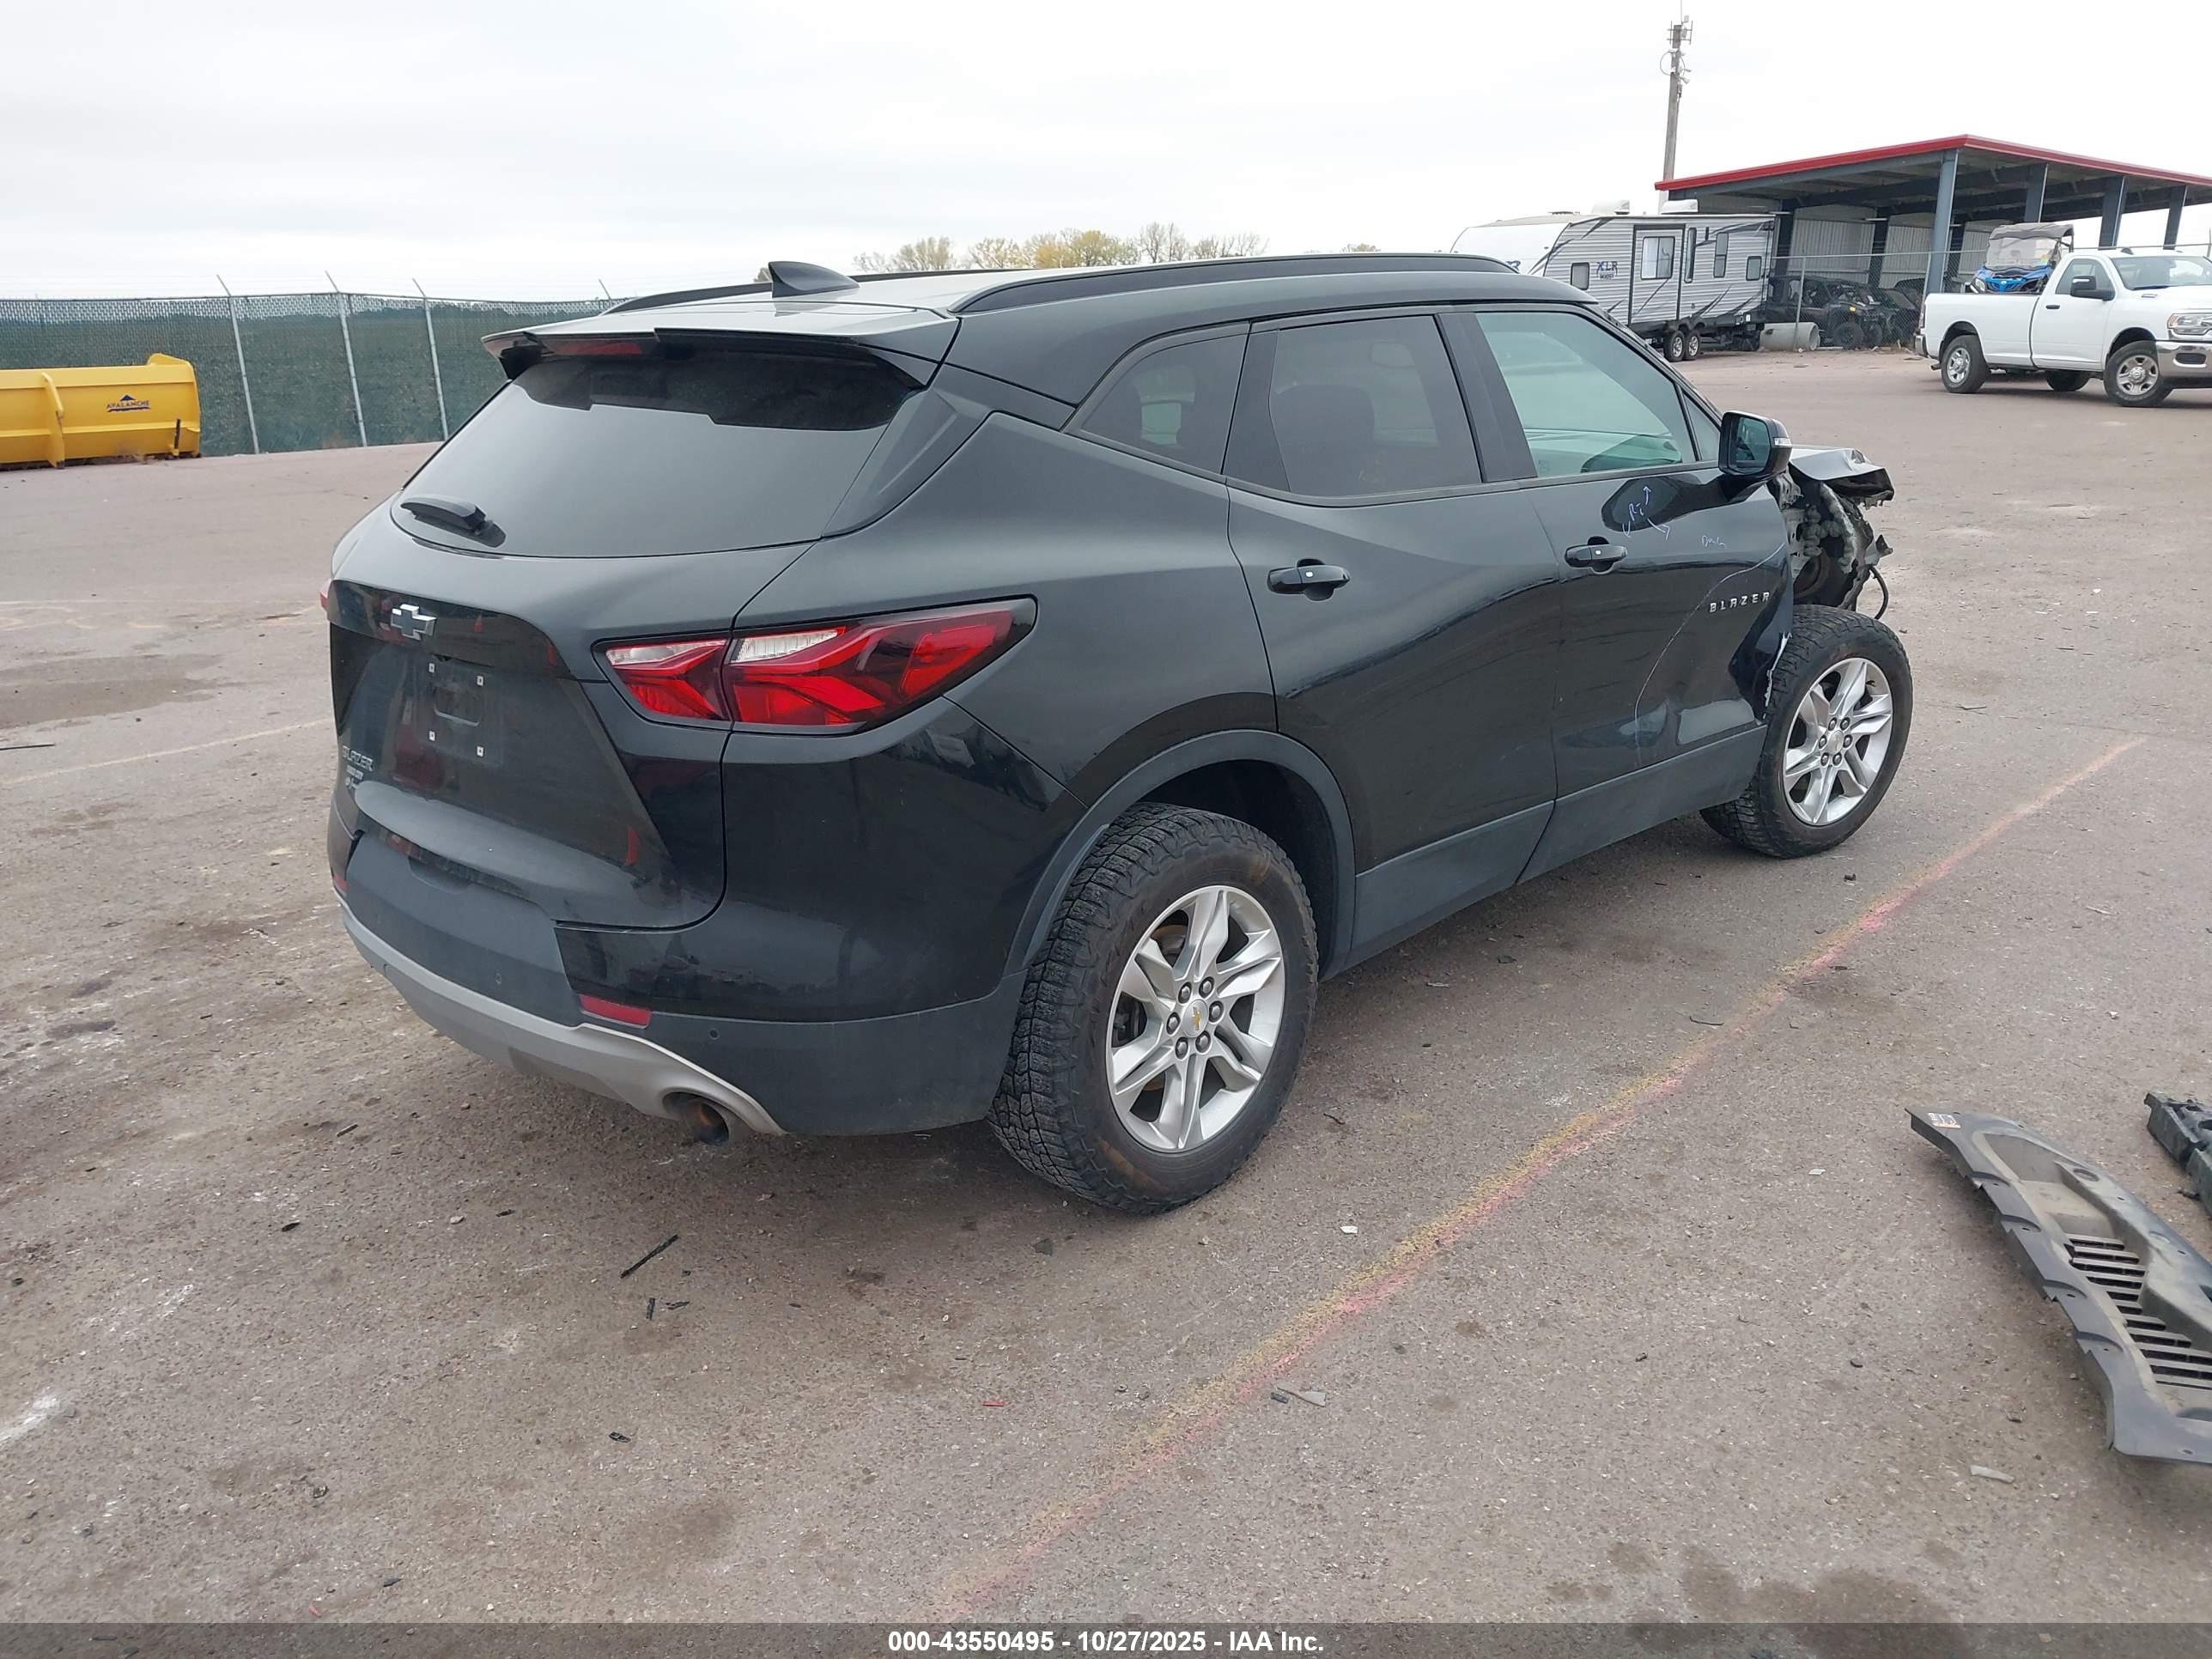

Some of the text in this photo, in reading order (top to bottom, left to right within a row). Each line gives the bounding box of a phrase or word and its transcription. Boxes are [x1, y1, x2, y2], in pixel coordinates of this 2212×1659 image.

[1596, 261, 1618, 275] XLR
[106, 400, 149, 409] AVALANCHE
[1709, 592, 1770, 613] BLAZER
[343, 745, 374, 771] BLAZER
